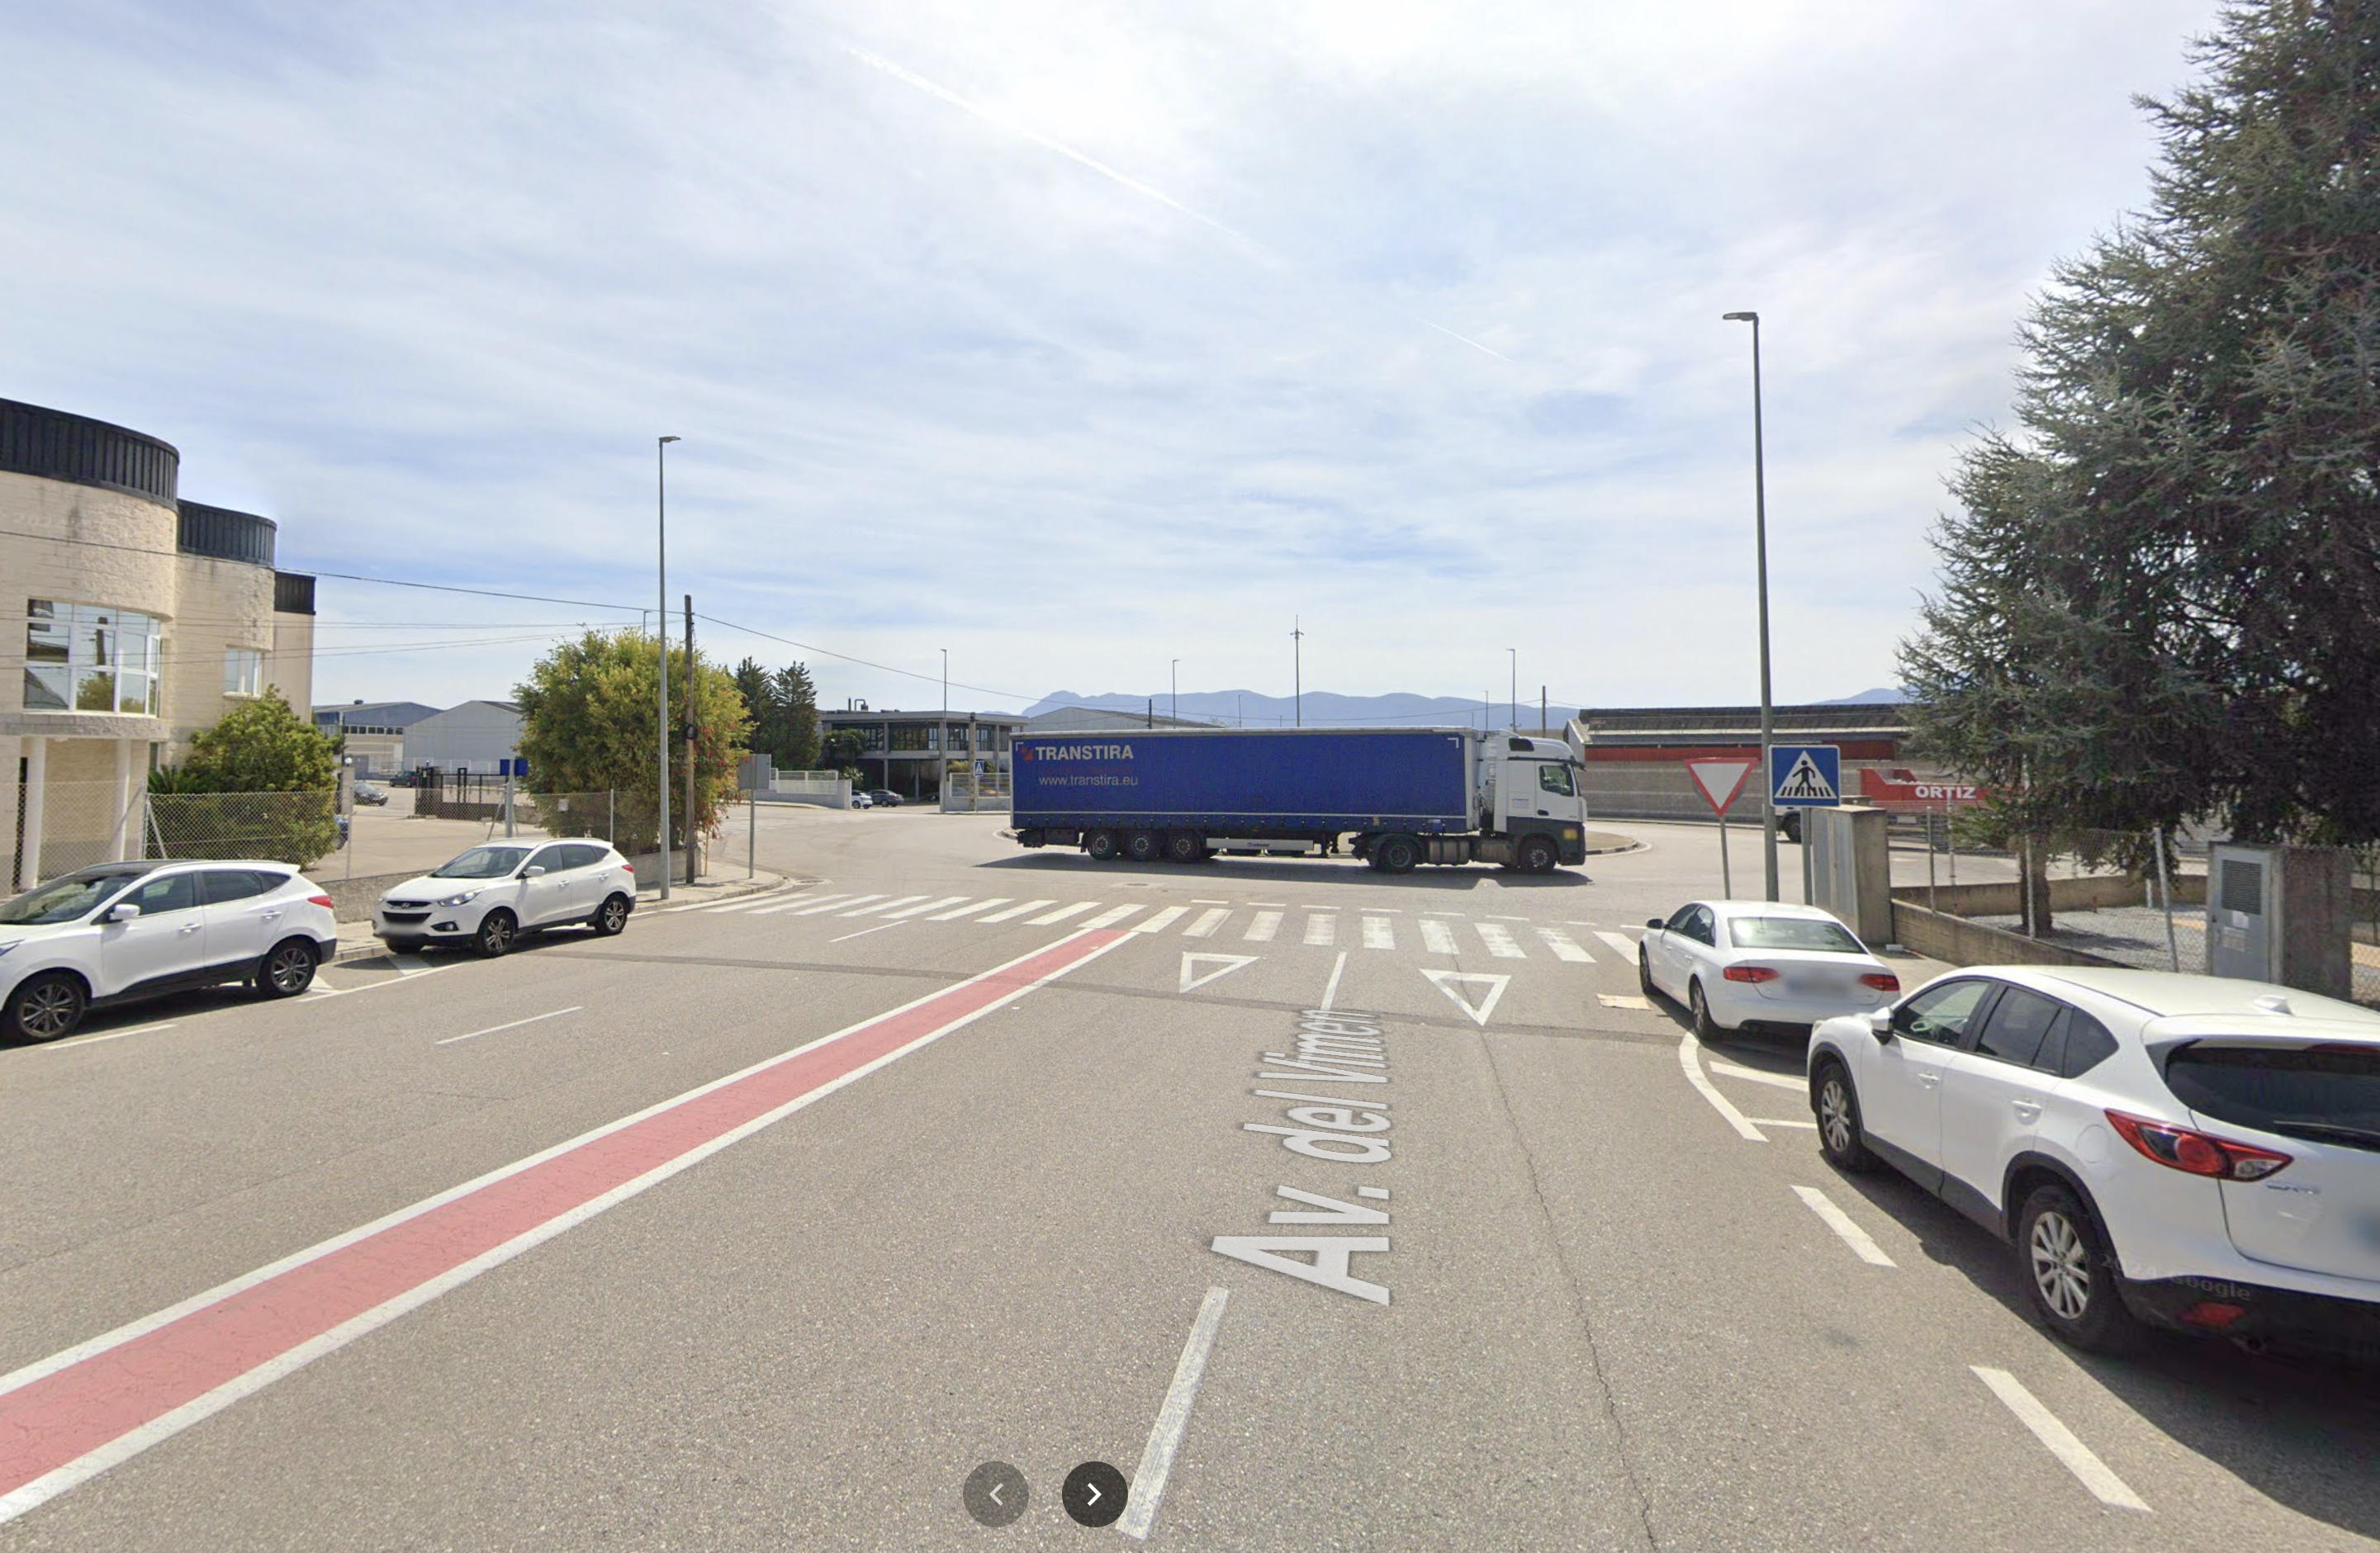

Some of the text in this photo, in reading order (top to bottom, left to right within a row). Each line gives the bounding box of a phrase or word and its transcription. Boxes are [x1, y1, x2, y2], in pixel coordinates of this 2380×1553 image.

[1035, 745, 1135, 760] TRANSTIRA
[1039, 774, 1138, 785] www.transtira.eu
[1915, 786, 1976, 799] ORTIZ
